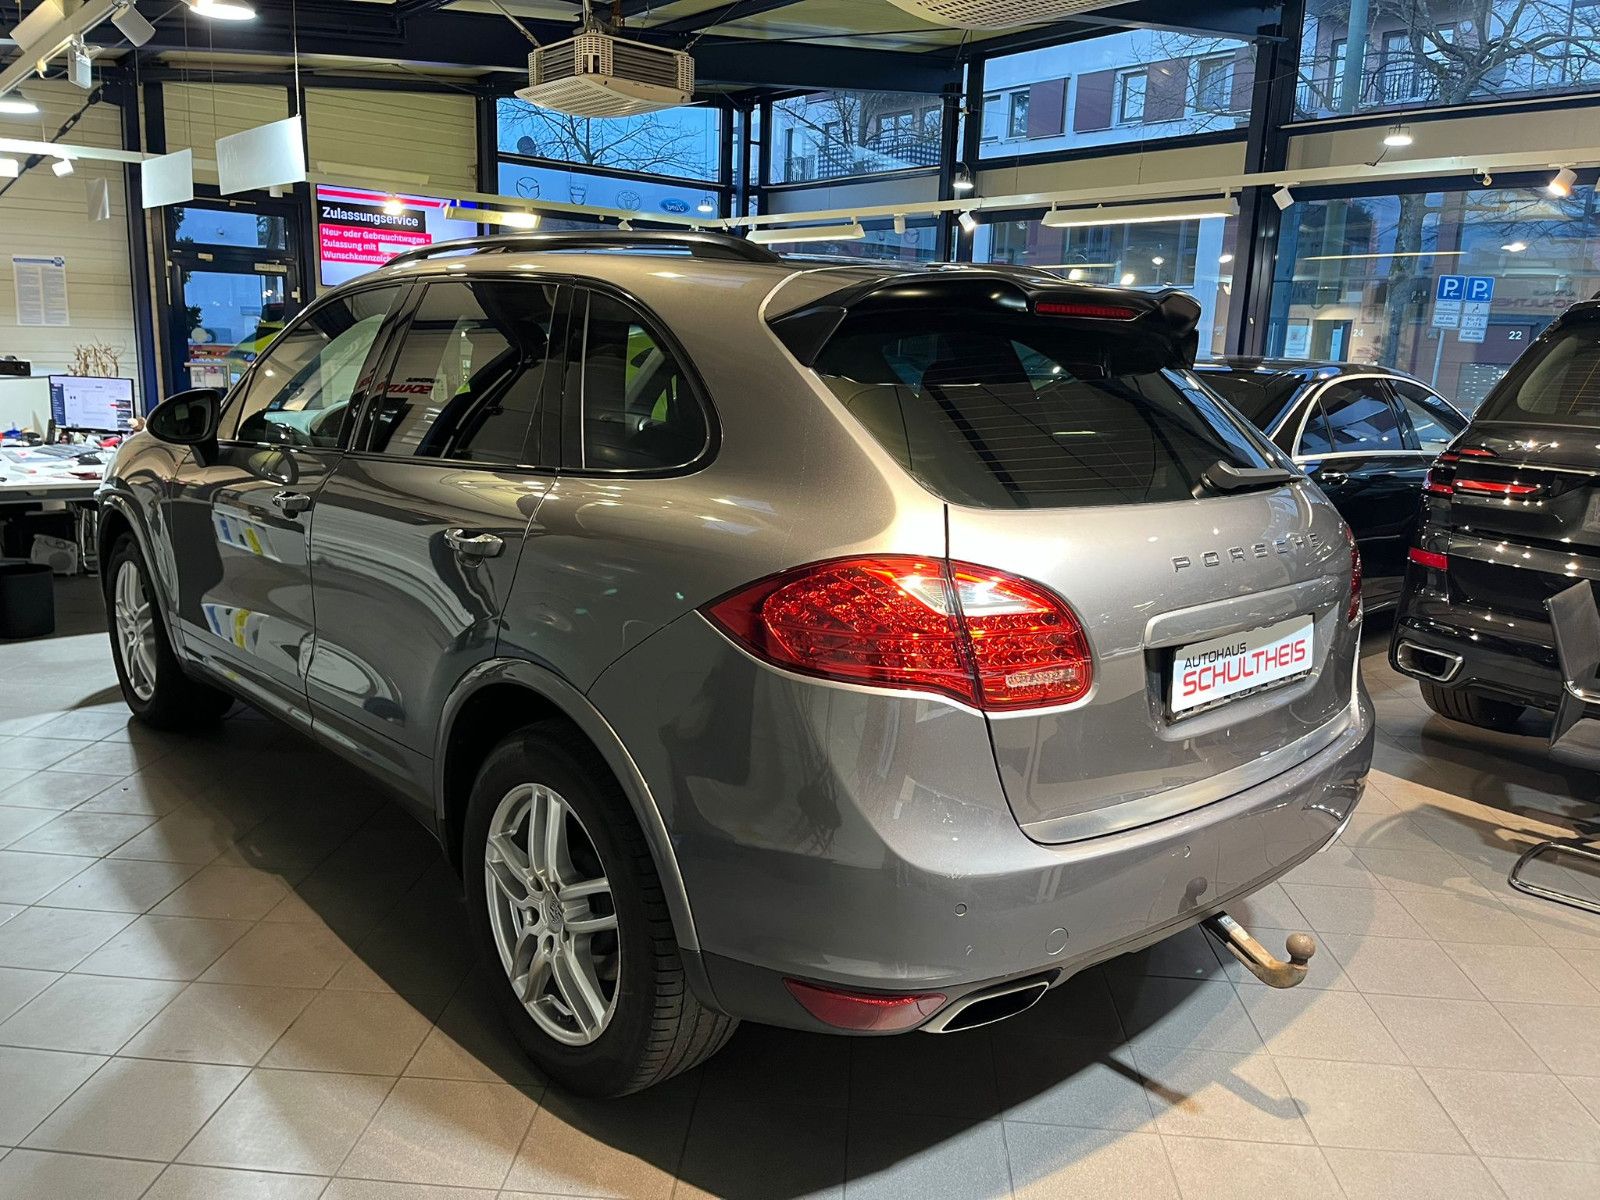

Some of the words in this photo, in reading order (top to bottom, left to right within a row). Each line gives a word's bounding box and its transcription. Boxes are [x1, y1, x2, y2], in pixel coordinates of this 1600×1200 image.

[322, 206, 419, 227] Zulassungservice
[322, 228, 342, 237] Neu-
[343, 230, 362, 238] oder
[363, 232, 425, 244] Gebrauchtwagen
[323, 239, 362, 251] Zulassung
[363, 243, 377, 251] mit
[1443, 279, 1459, 297] P
[1472, 280, 1488, 299] P
[1353, 329, 1364, 337] 24
[1508, 330, 1522, 340] 22
[1171, 533, 1320, 573] PORSCHE
[1184, 642, 1247, 670] AUTOHAUS
[1183, 640, 1306, 697] SCHULTHEIS
